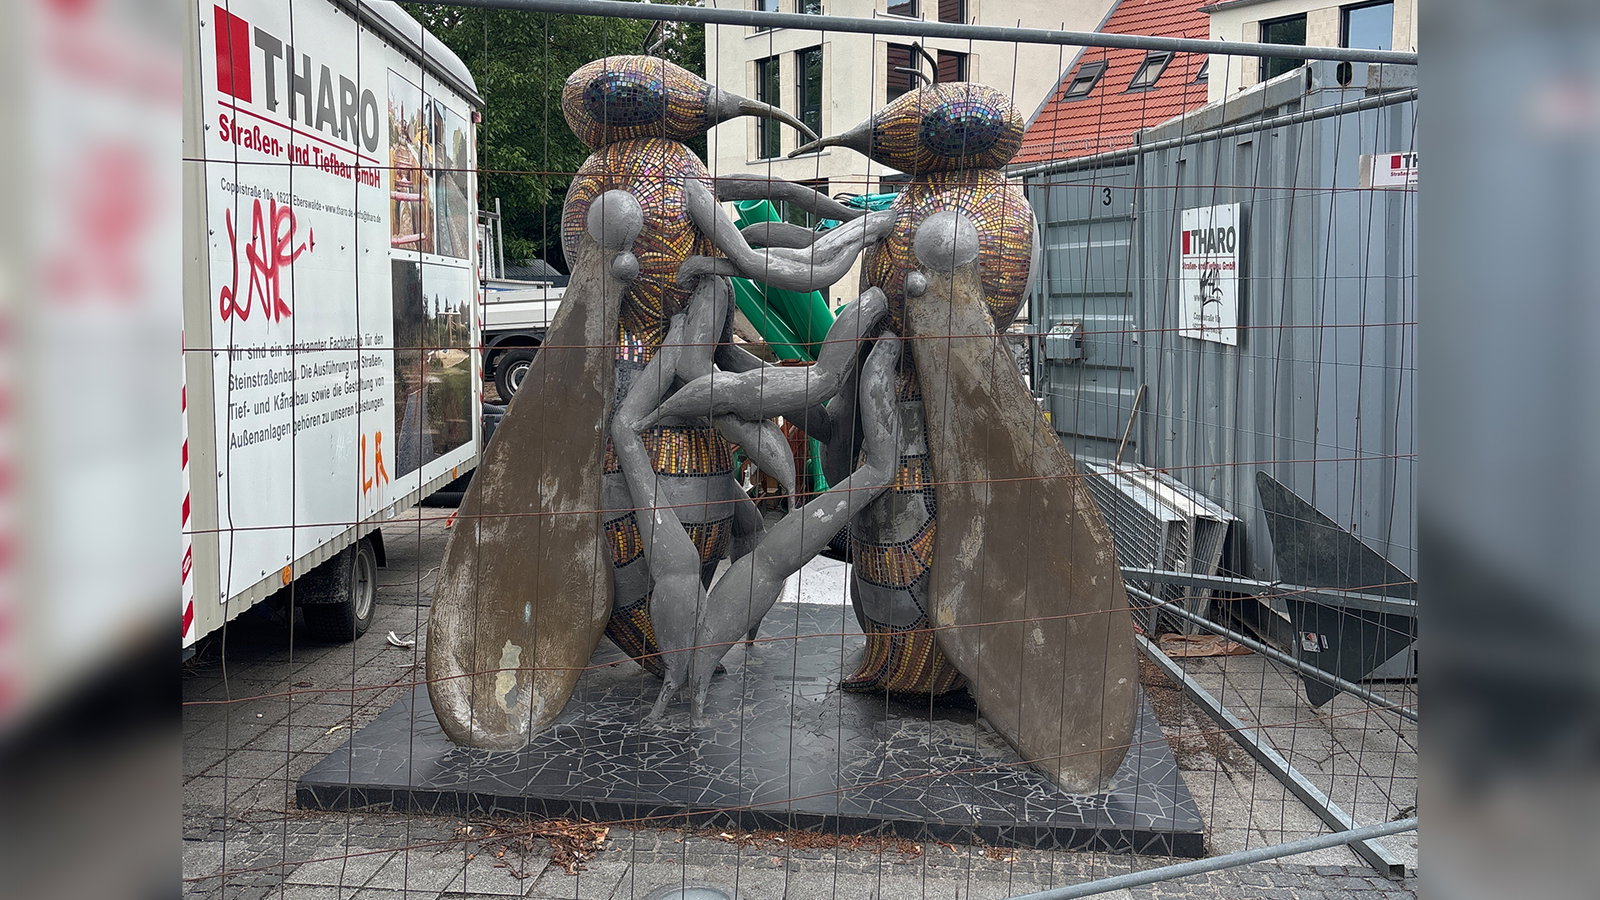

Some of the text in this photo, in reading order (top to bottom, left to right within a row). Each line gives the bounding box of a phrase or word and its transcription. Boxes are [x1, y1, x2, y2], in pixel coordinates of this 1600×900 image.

[254, 26, 380, 153] THARO
[219, 114, 381, 189] Straßen- und Tiefbau GmbH
[221, 178, 261, 199] Coppistraße
[293, 195, 322, 211] Eberswalde
[1103, 187, 1111, 206] 3
[1191, 226, 1236, 254] THARO
[227, 332, 384, 361] Wir sind ein anerkannter Fachbetrieb für den
[229, 368, 299, 391] Steinstraßenbau.
[301, 364, 312, 379] Die
[313, 360, 349, 377] Ausführung
[229, 376, 385, 421] Tief- und Kanalbau sowie die Gestaltung von
[230, 422, 291, 450] Außenanlagen
[293, 414, 320, 436] gehören
[322, 410, 329, 424] zu
[331, 404, 355, 421] unseren
